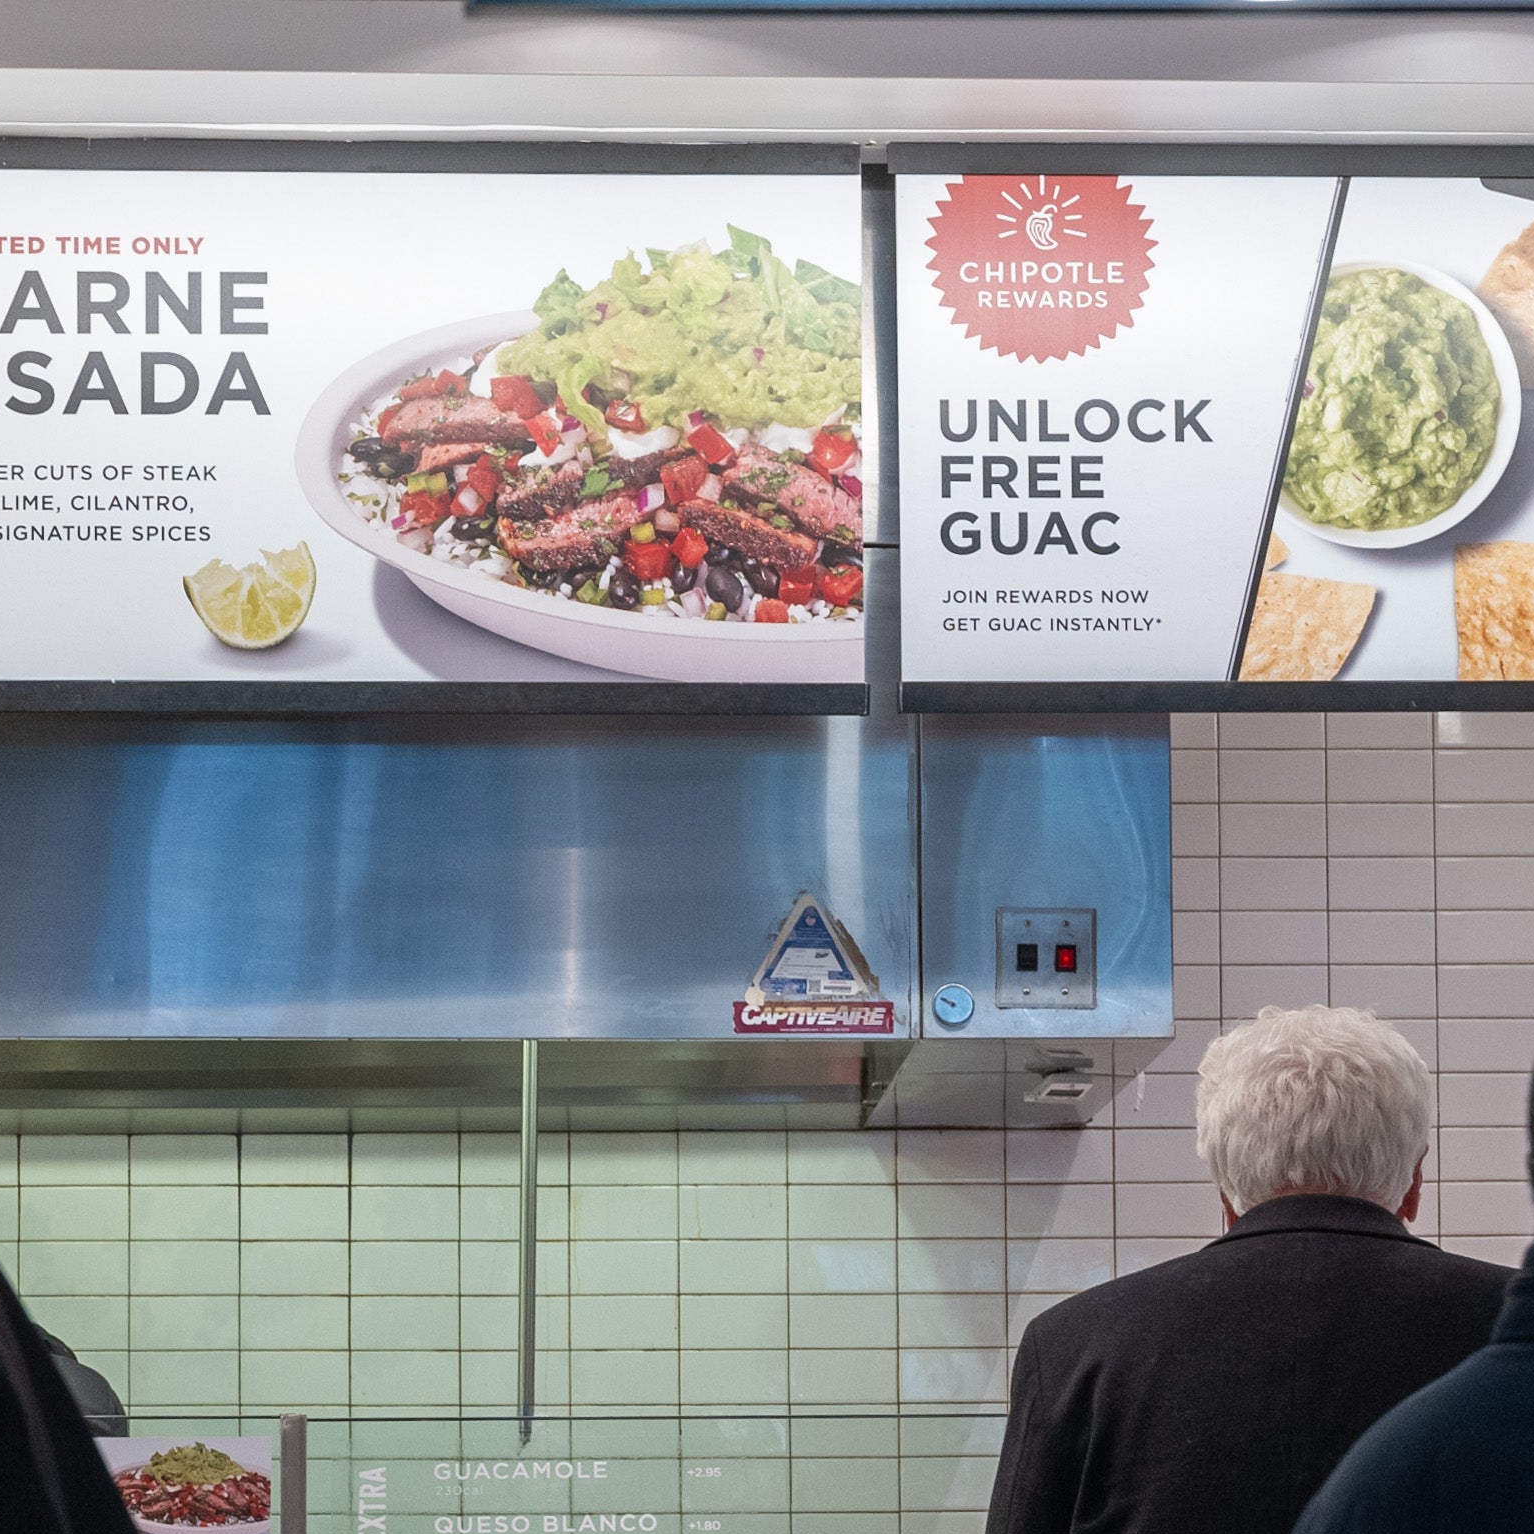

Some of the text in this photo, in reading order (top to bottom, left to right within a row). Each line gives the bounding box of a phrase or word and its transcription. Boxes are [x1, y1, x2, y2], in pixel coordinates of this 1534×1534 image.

[56, 237, 120, 254] TIME
[132, 237, 204, 254] ONLY
[960, 262, 1124, 284] CHIPOTLE
[978, 290, 1107, 308] REWARDS
[940, 399, 1213, 443] UNLOCK
[34, 465, 92, 480] CUTS
[103, 465, 133, 480] OF
[143, 465, 216, 481] STEAK
[941, 456, 1104, 498] FREE
[2, 495, 60, 513] LIME,
[71, 495, 193, 513] CILANTRO,
[132, 526, 210, 541] SPICES
[940, 512, 1120, 555] GUAC
[943, 590, 1148, 603] JOIN REWARDS NOW
[943, 618, 980, 631] GET
[988, 618, 1041, 631] GUAC
[434, 1462, 607, 1480] GUACAMOLE
[687, 1468, 721, 1478] +2.95
[436, 1485, 483, 1496] 230cal
[435, 1514, 657, 1533] QUESO BLANCO
[689, 1521, 721, 1532] +1.80
